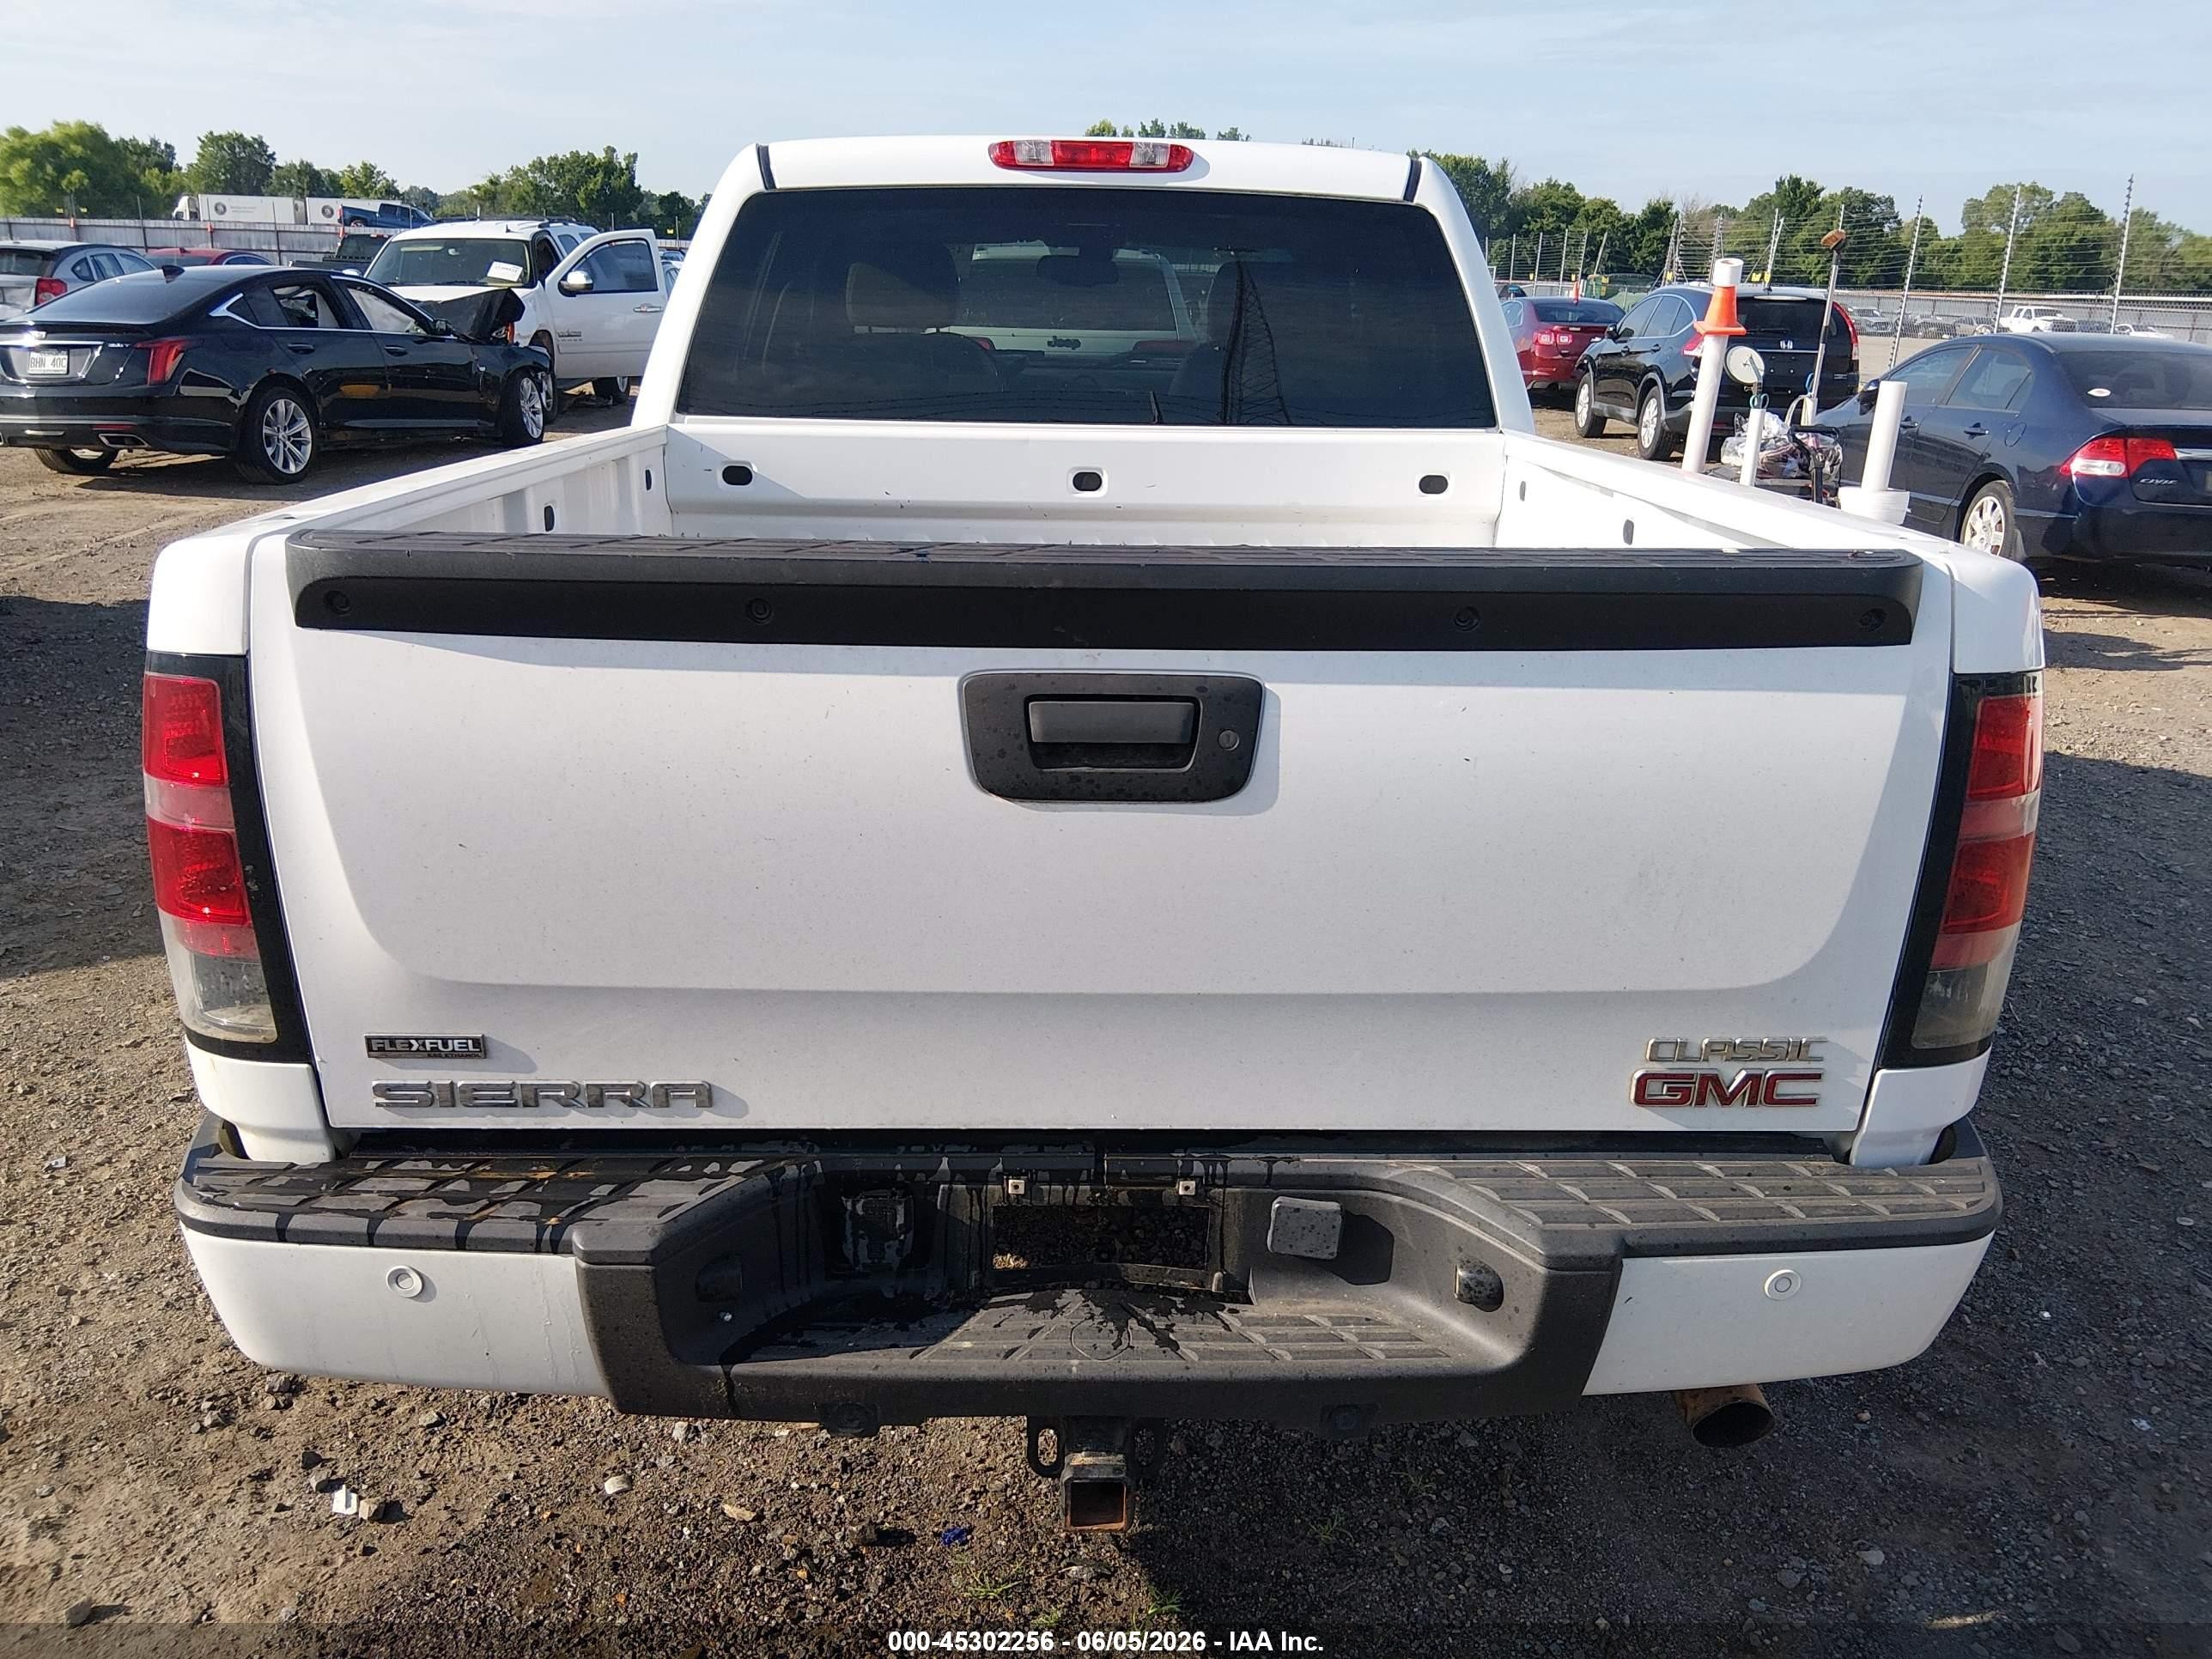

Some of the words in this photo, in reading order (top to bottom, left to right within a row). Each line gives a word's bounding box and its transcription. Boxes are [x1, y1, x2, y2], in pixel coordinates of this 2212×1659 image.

[1047, 336, 1081, 350] Jeep
[1645, 1036, 1827, 1062] CLASSIC
[371, 1079, 714, 1108] SIERRA
[1630, 1067, 1826, 1108] GMC
